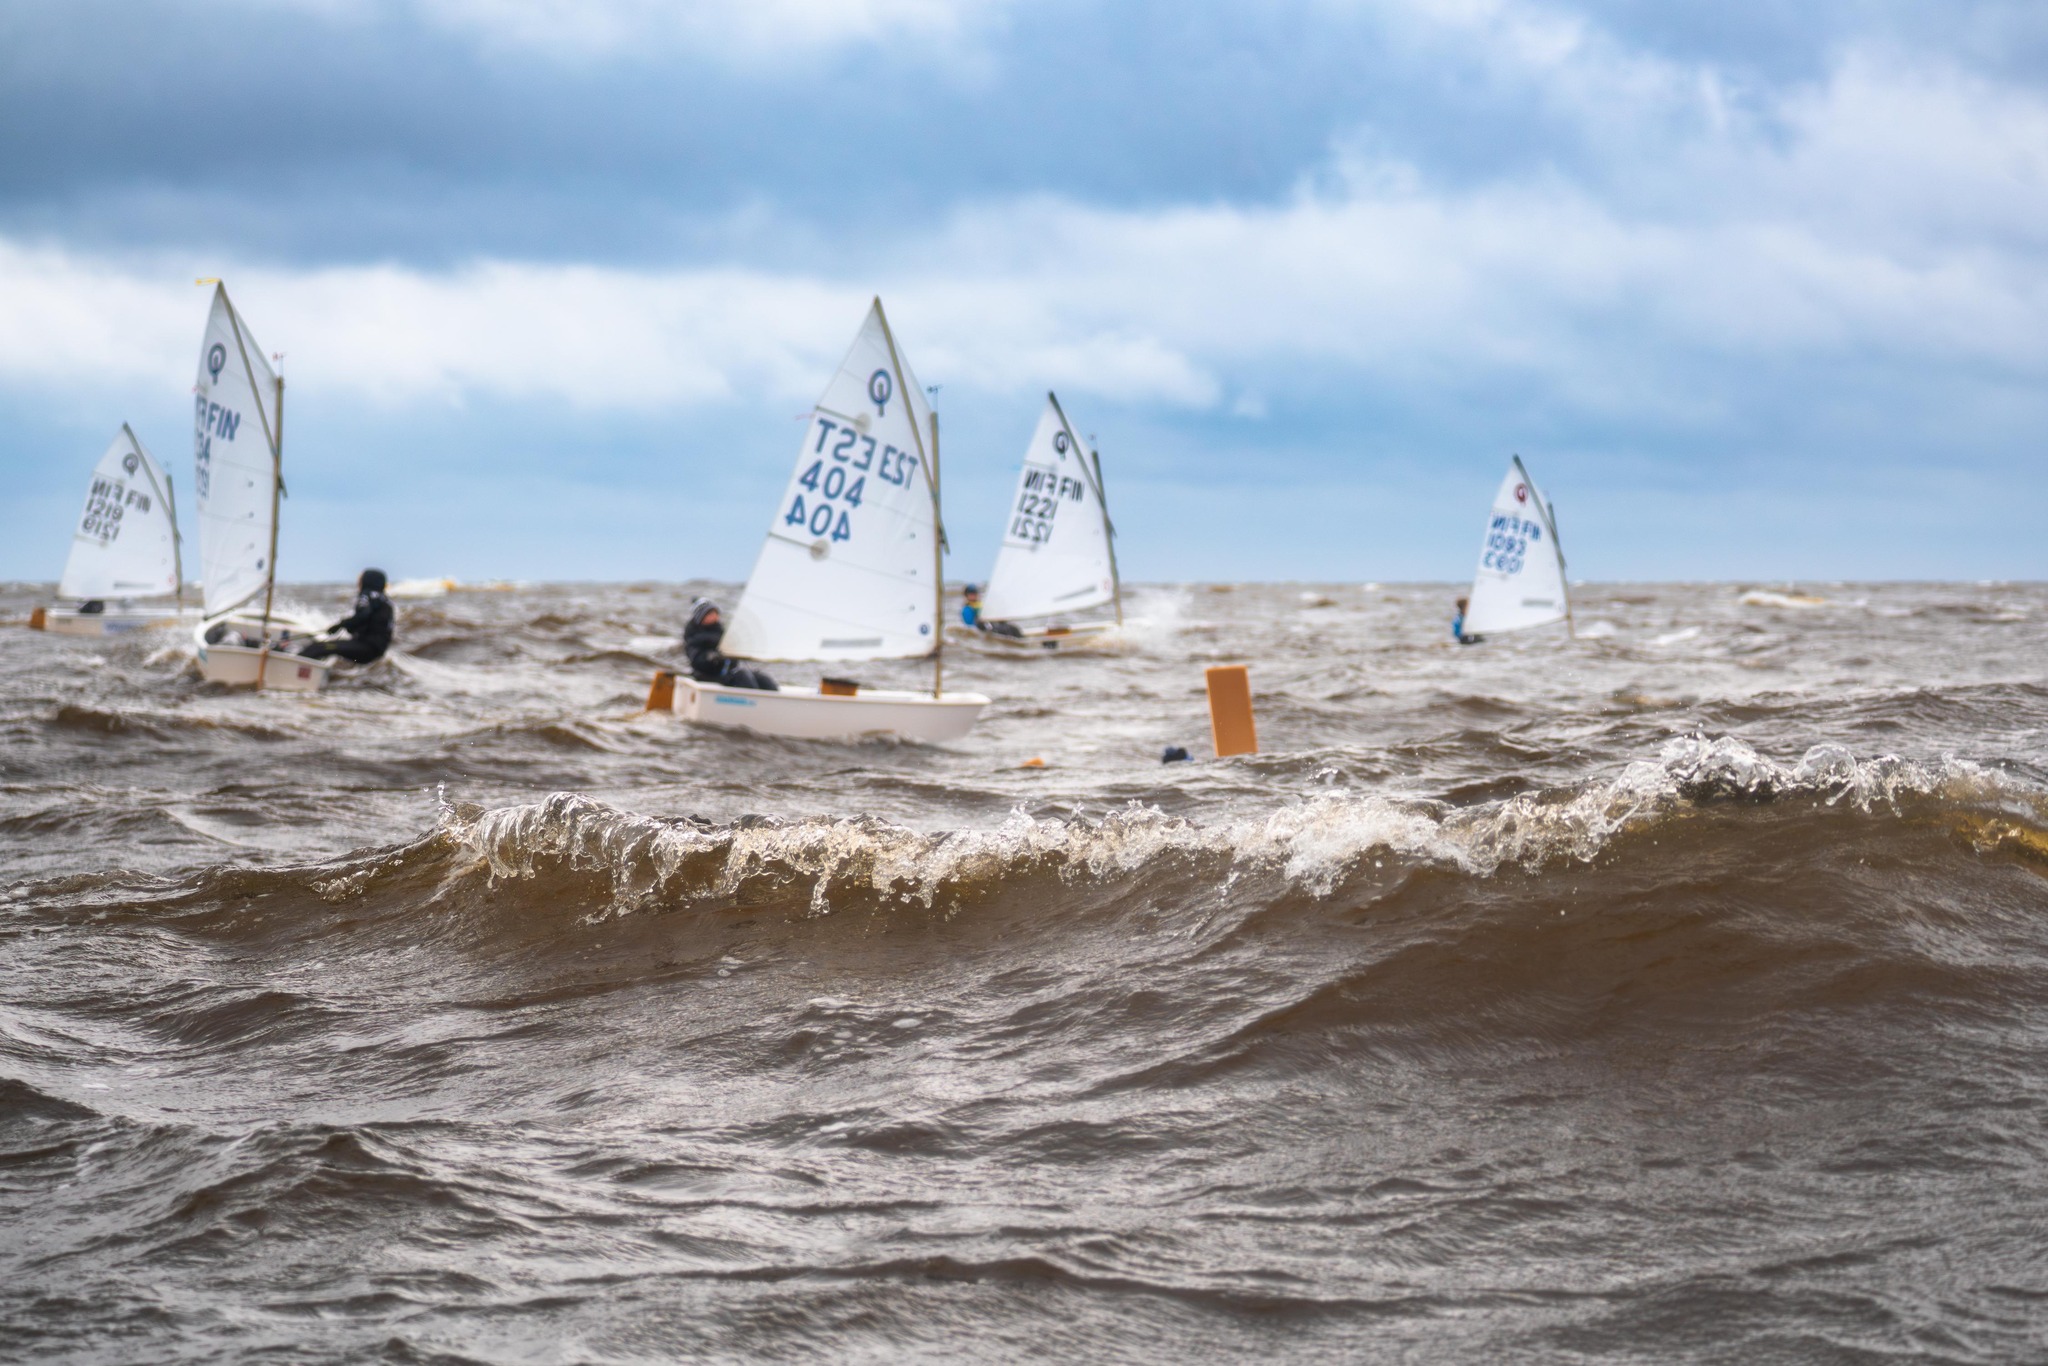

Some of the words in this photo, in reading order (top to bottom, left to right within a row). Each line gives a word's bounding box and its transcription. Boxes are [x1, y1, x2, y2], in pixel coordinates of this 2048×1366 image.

[207, 402, 241, 442] FIN
[799, 459, 866, 508] 404
[878, 444, 918, 490] EST
[1017, 493, 1058, 521] 1221
